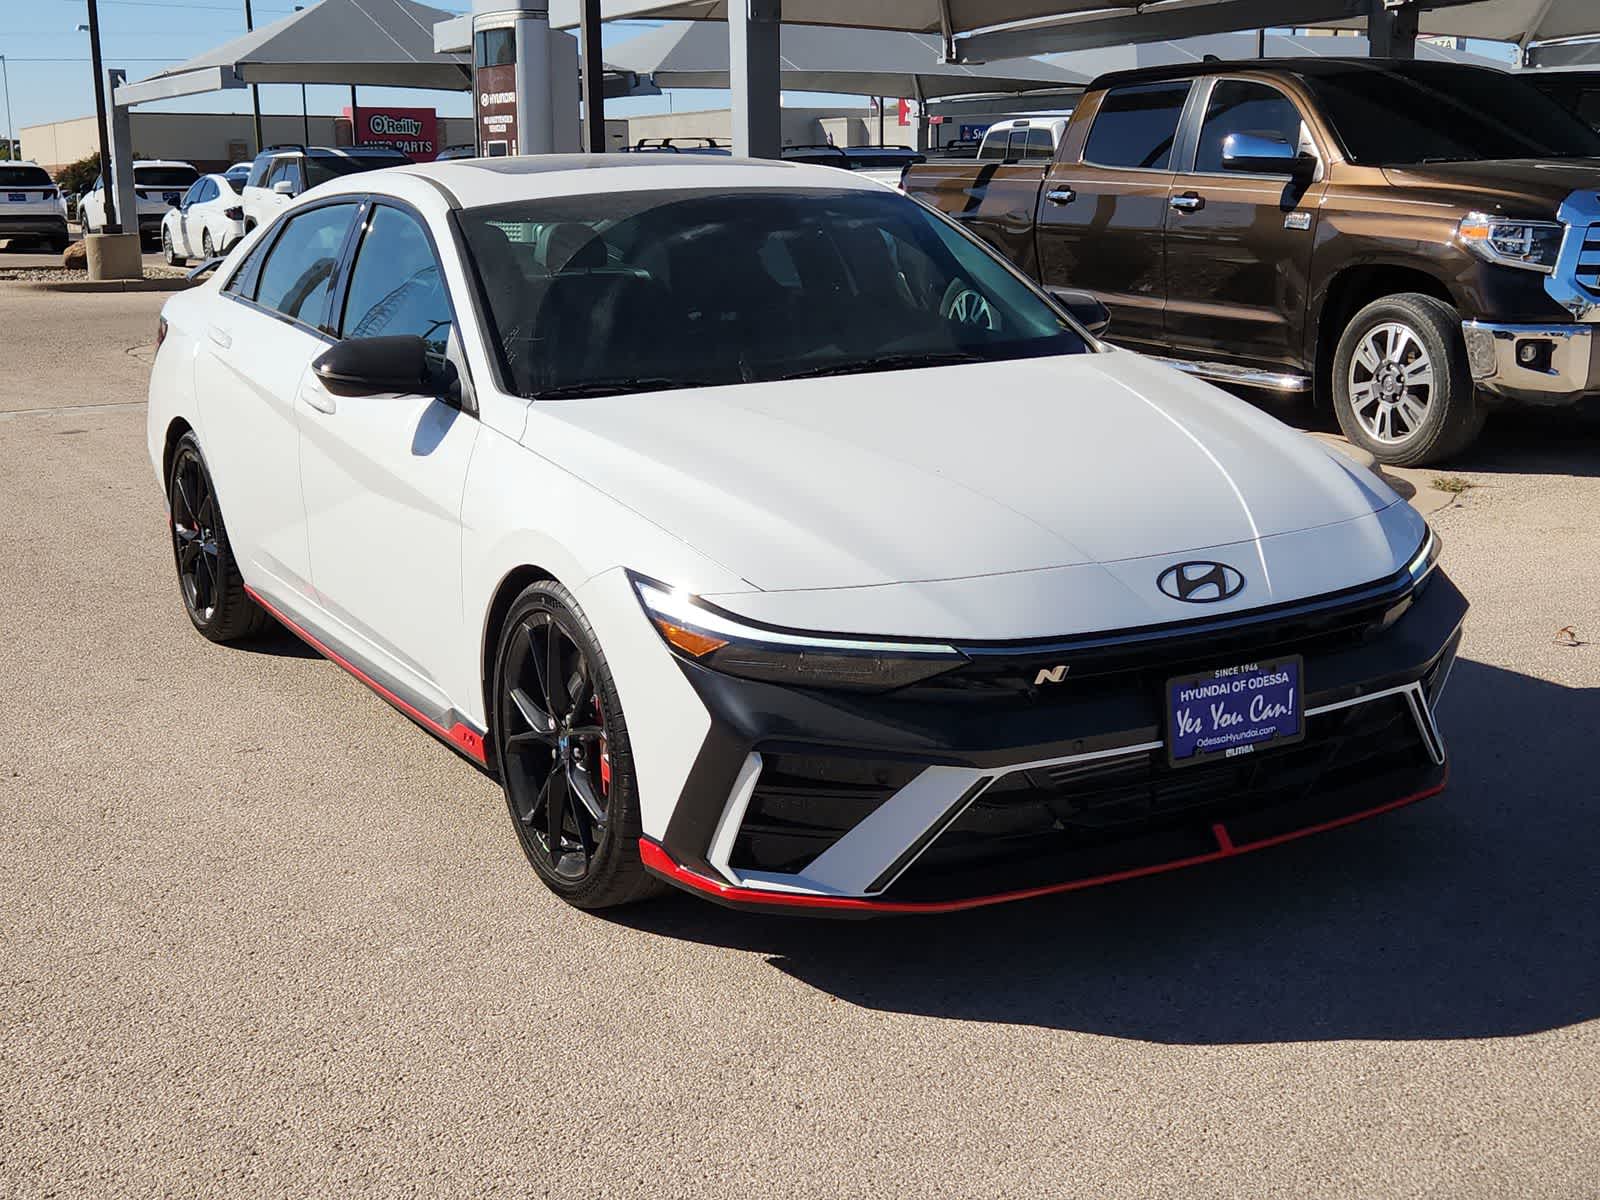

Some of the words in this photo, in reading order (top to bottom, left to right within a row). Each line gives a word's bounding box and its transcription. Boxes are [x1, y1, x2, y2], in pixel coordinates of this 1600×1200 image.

[370, 115, 421, 136] O'Reilly
[396, 141, 432, 153] PARTS
[1215, 666, 1239, 679] SINCE
[1241, 663, 1258, 673] 1946
[1180, 684, 1230, 702] HYUNDAI
[1231, 680, 1247, 693] OF
[1249, 672, 1289, 690] ODESSA
[1176, 707, 1203, 737] Yes
[1210, 701, 1243, 730] You
[1250, 687, 1294, 722] Can!
[1197, 726, 1277, 748] OdessaHyundai.com
